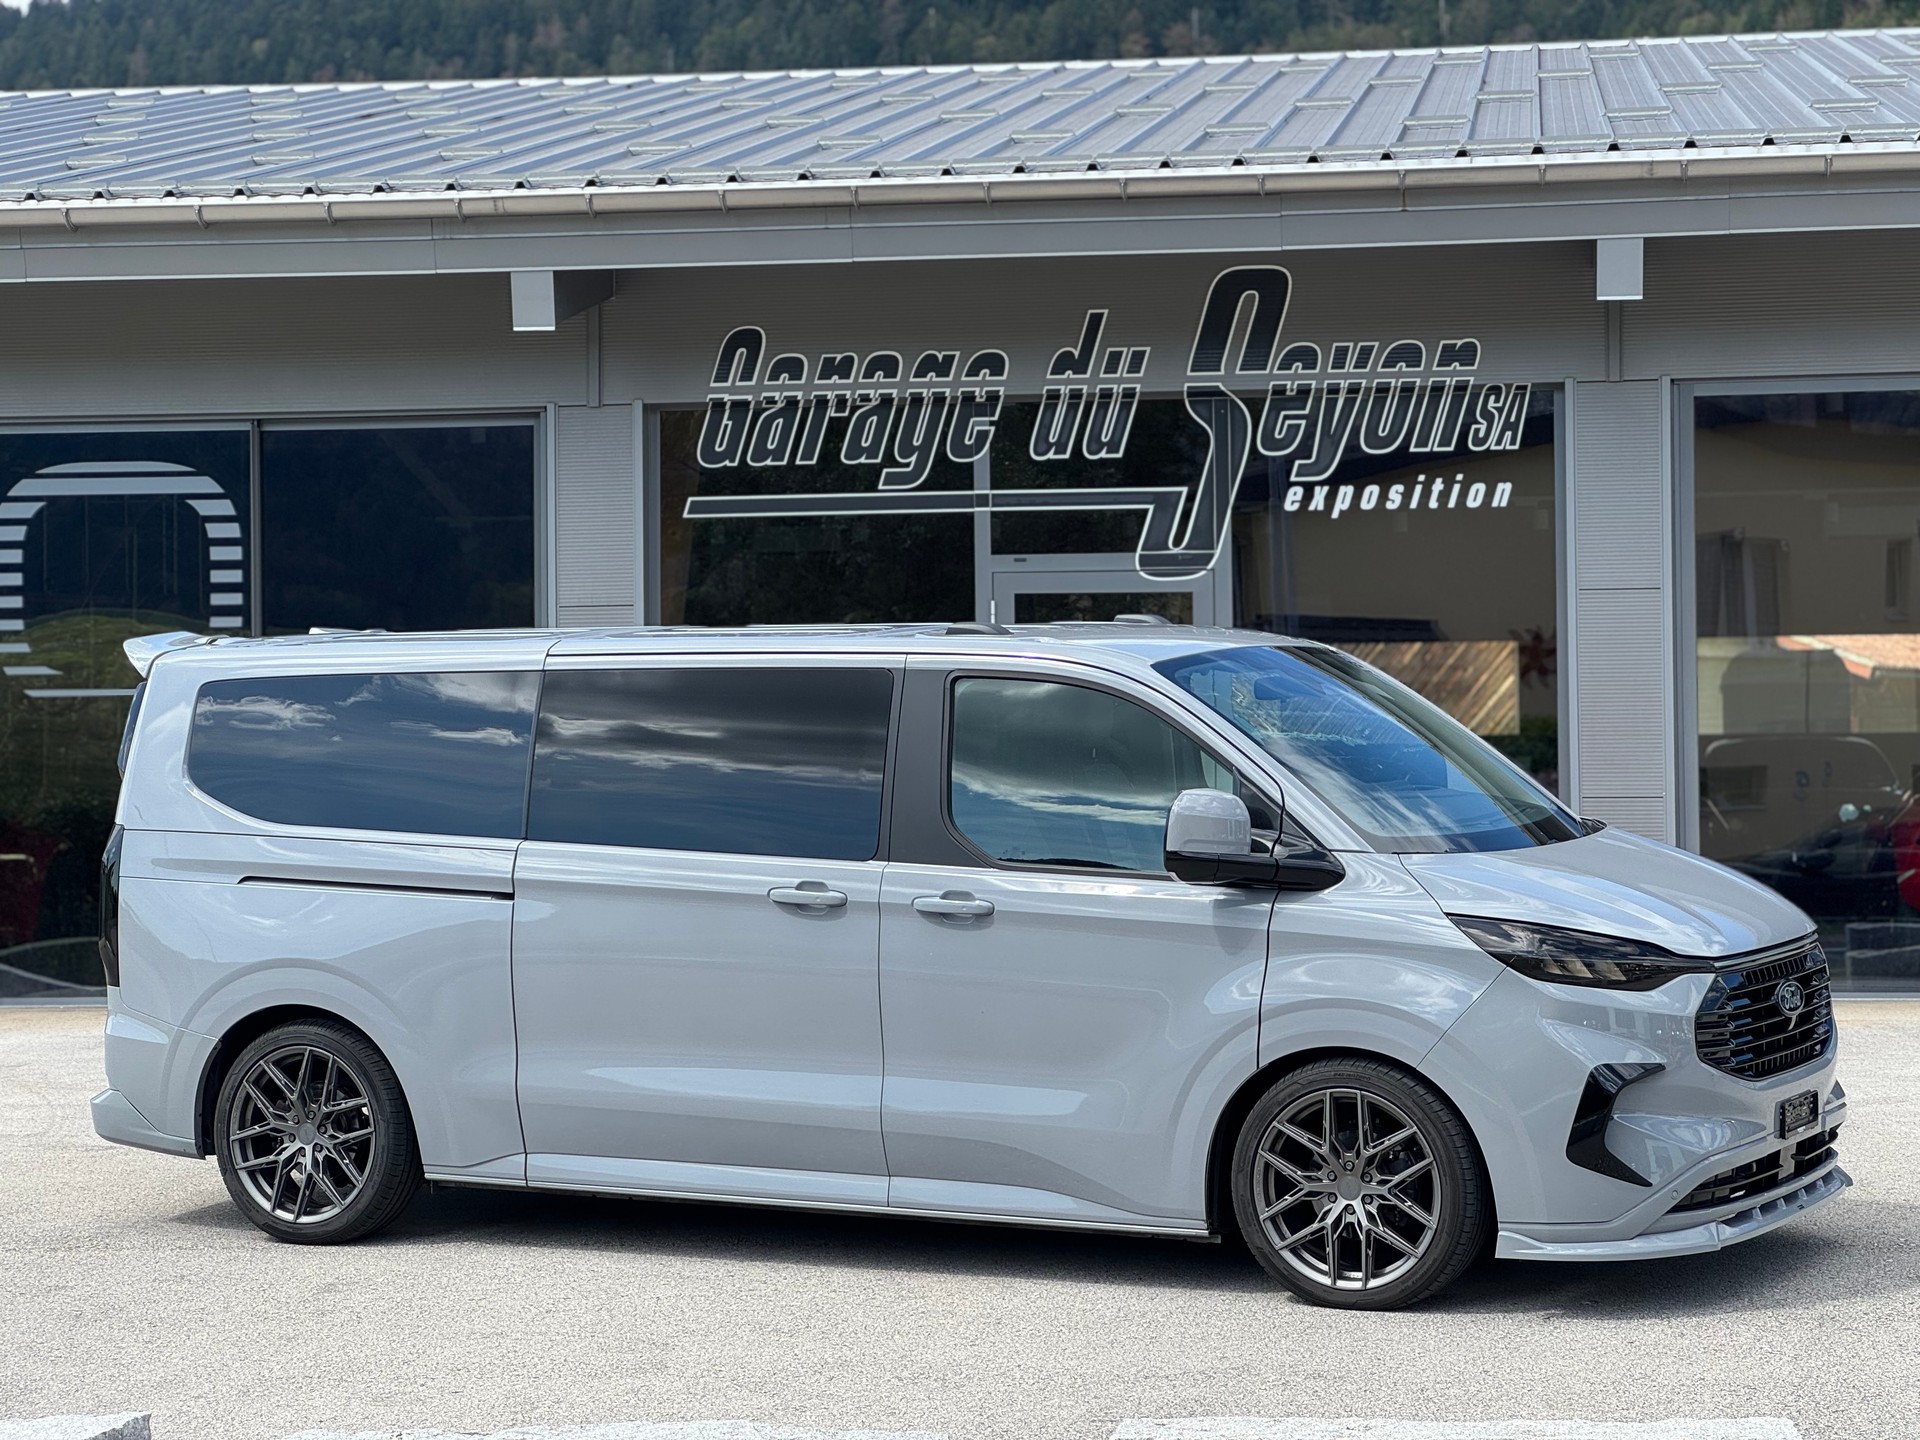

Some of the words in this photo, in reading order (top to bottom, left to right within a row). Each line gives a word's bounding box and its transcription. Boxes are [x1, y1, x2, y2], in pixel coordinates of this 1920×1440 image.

[697, 325, 1010, 490] Garage
[1029, 309, 1151, 461] du
[1136, 265, 1482, 582] Seyon
[1467, 382, 1532, 452] SA
[1283, 473, 1513, 519] exposition
